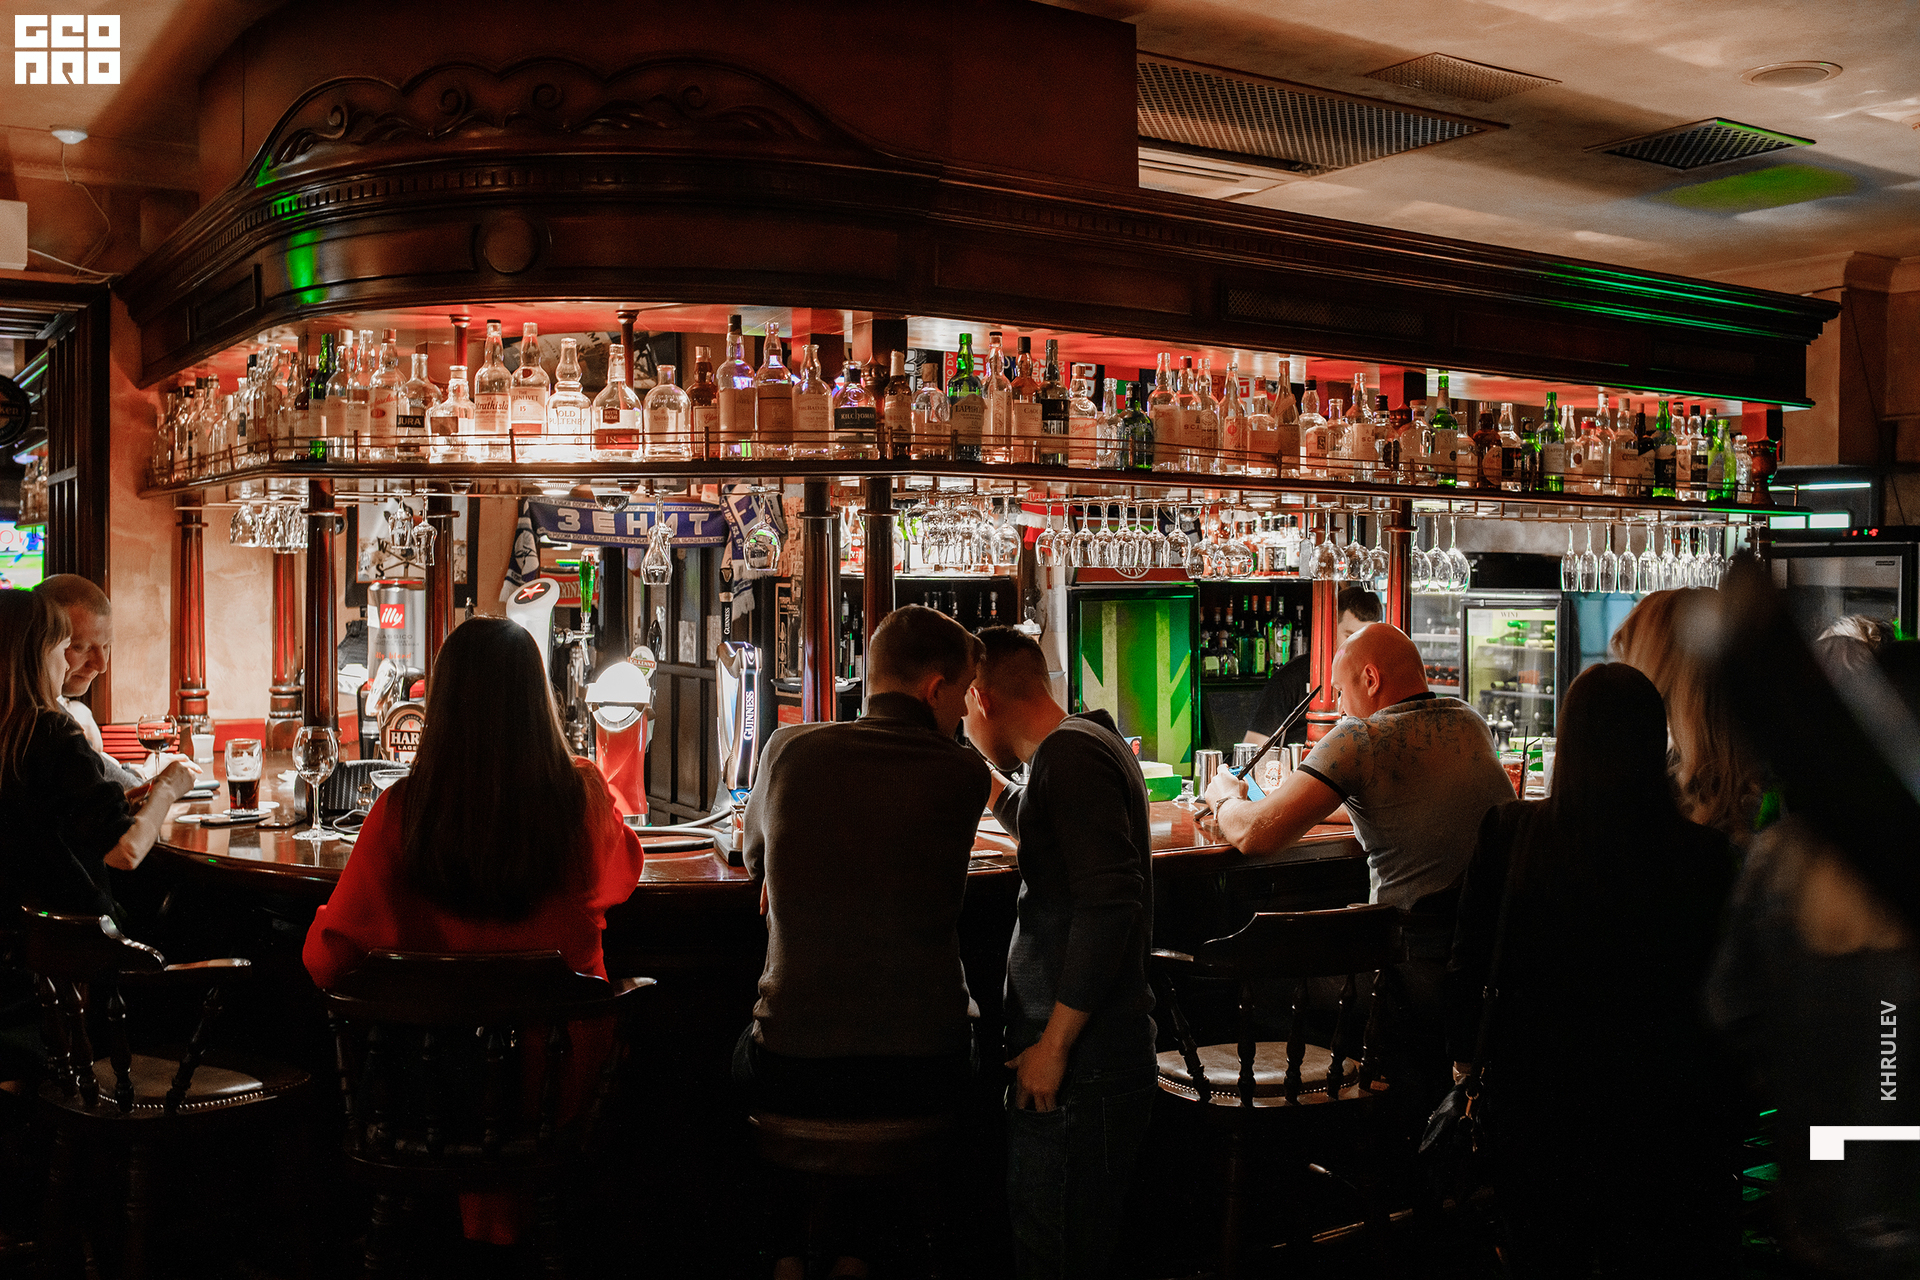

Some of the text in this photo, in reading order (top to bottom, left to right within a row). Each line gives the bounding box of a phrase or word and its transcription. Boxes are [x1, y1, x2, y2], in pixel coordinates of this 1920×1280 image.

[559, 410, 576, 418] OLD
[398, 417, 421, 426] JURA
[557, 507, 710, 536] ЗЕНИТ
[381, 607, 404, 627] illy
[723, 607, 731, 635] GUINNESS
[389, 652, 411, 660] blend
[629, 657, 655, 668] KILKENNY
[743, 690, 755, 741] GUINNESS
[390, 731, 420, 745] HAR
